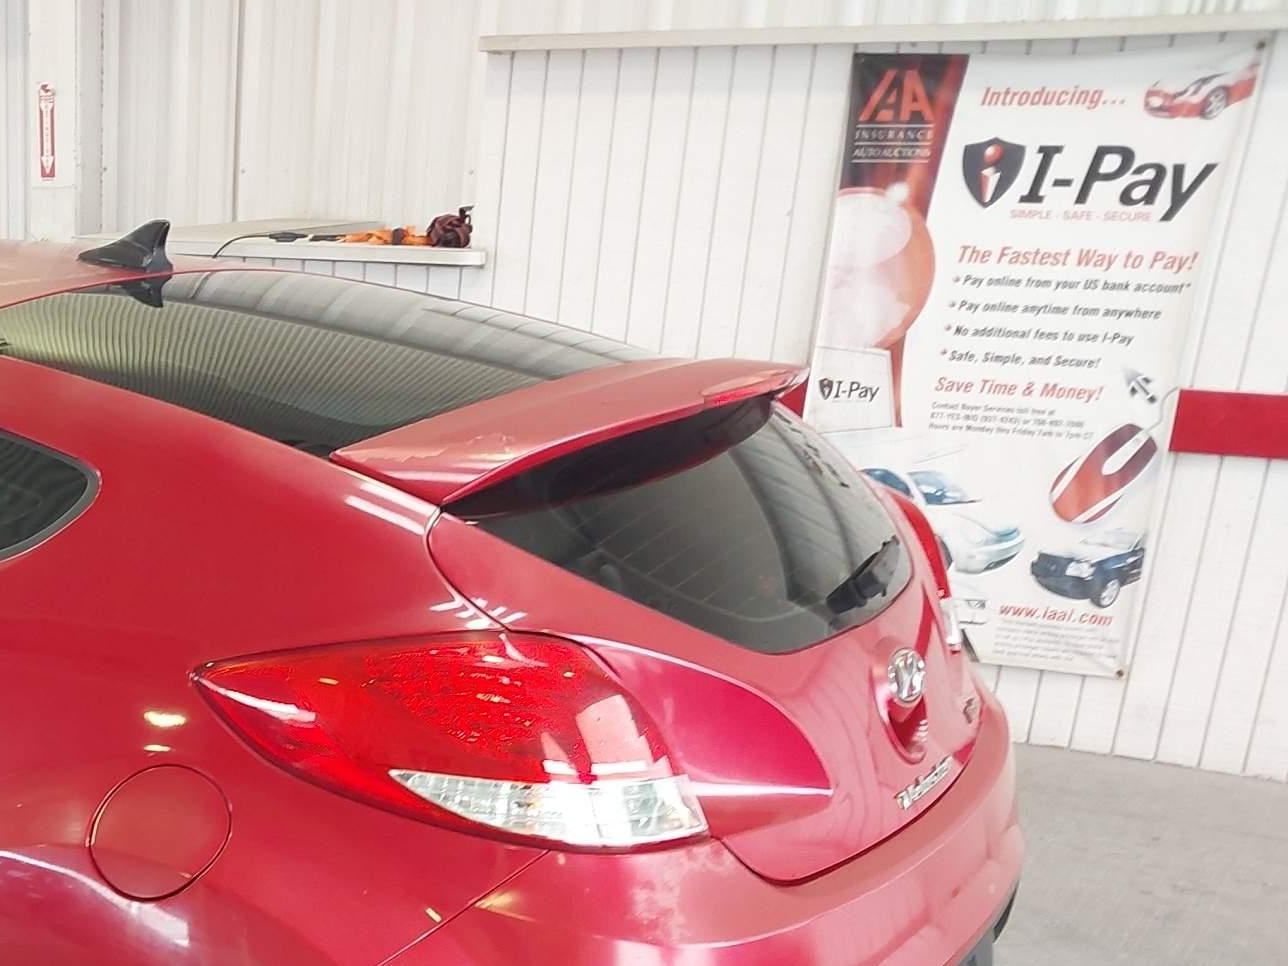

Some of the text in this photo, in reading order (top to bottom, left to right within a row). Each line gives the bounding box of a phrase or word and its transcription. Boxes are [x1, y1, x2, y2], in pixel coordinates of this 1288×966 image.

[980, 85, 1126, 110] Introducing...
[855, 129, 934, 140] INSURANCE
[1018, 145, 1219, 222] I-Pay
[1009, 210, 1152, 222] SIMPLE SAFE SECURE
[957, 245, 1199, 274] The Fastest Way to Pay!
[962, 274, 984, 288] Pay
[986, 276, 1022, 287] online
[1025, 276, 1052, 288] from
[1053, 280, 1081, 291] your
[1083, 279, 1099, 290] US
[1101, 280, 1130, 291] bank
[958, 300, 1162, 320] Pay online anytime from anywhere
[953, 325, 1136, 346] No additional fees to use I-Pay
[948, 350, 1102, 369] Safe, Simple, and Secure!
[833, 380, 880, 402] I-Pay
[935, 376, 1105, 404] Save Time & Money!
[999, 604, 1114, 626] www.iaai.com
